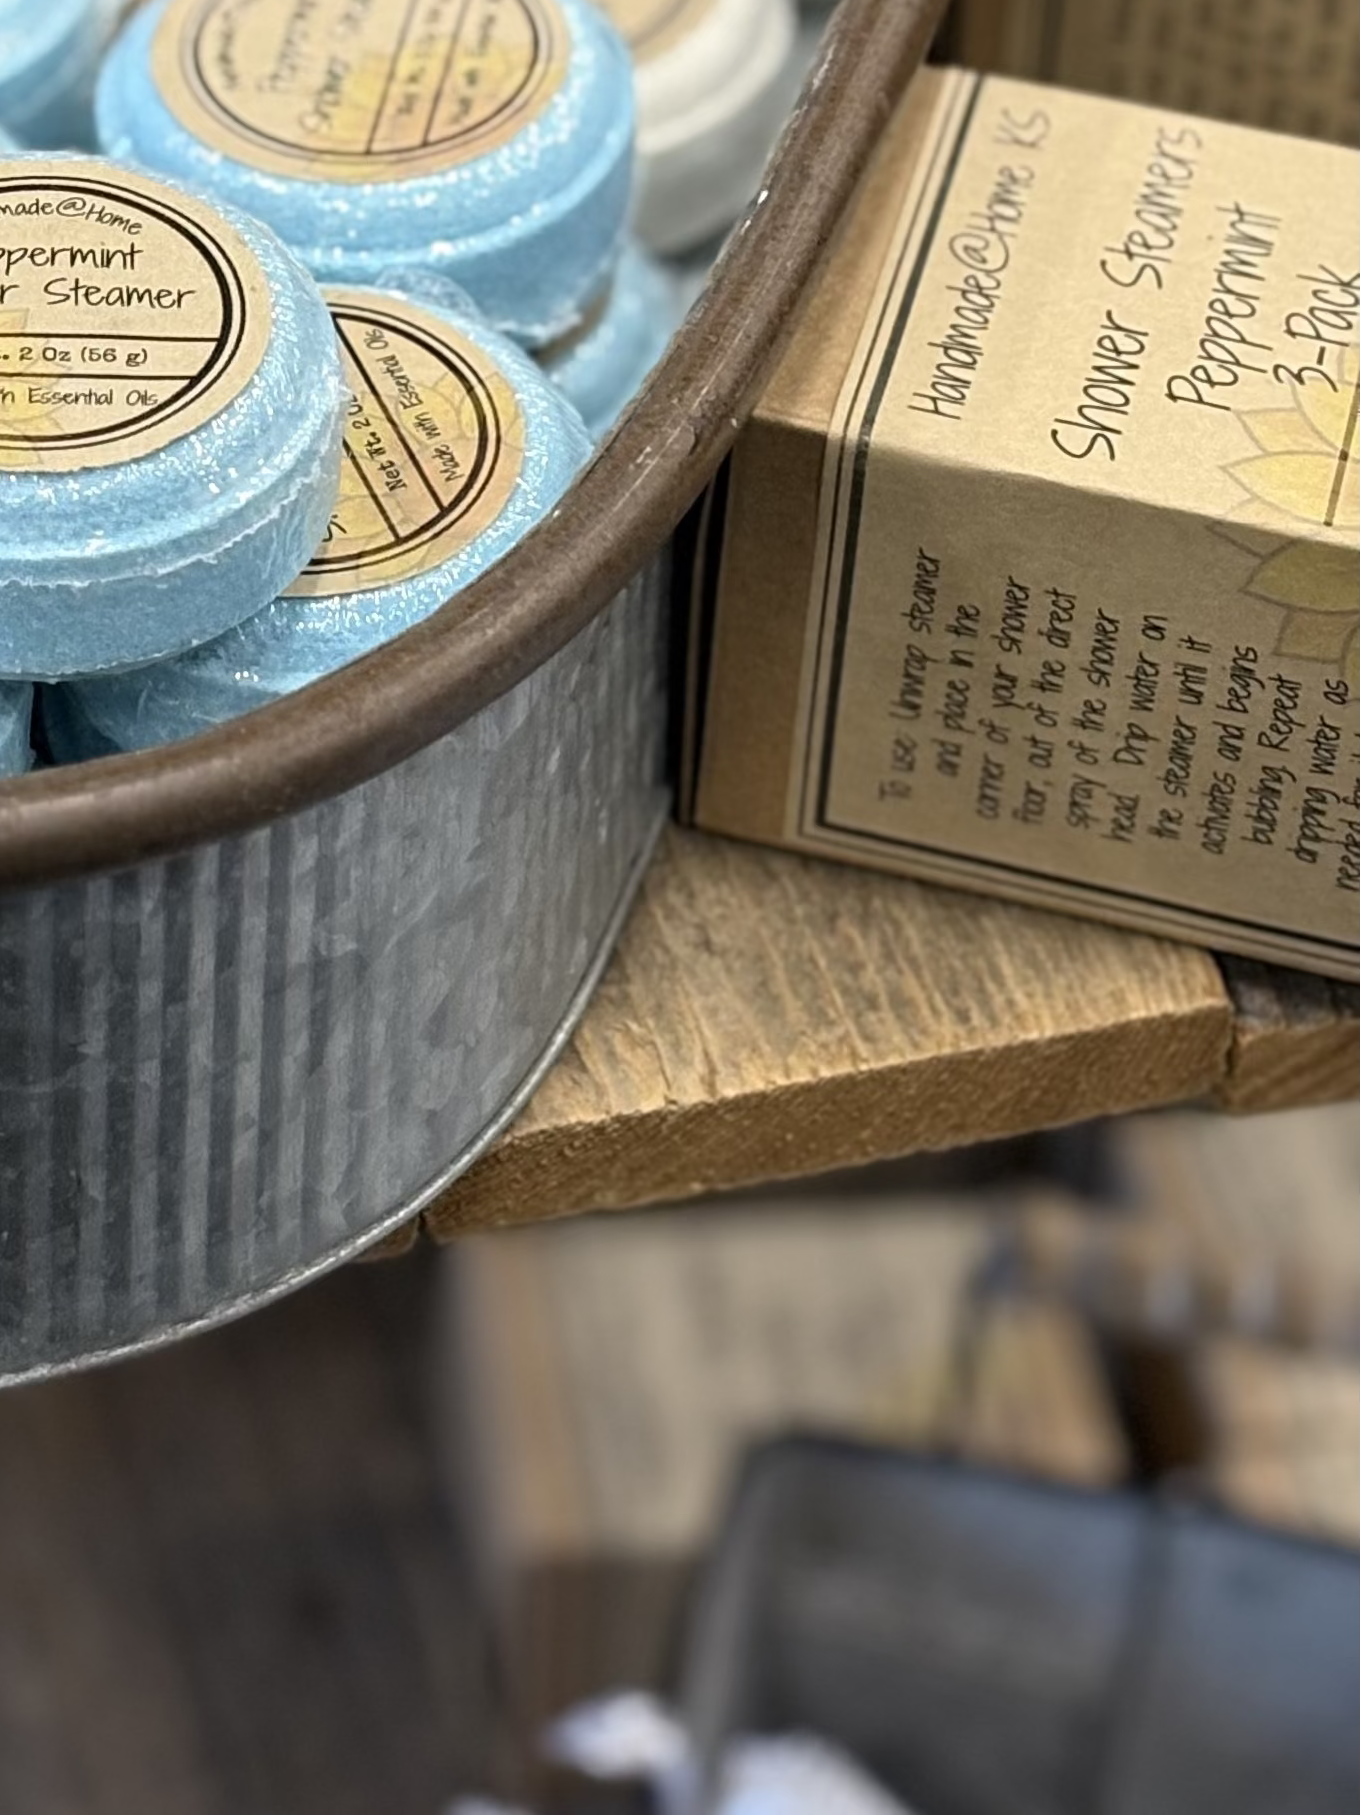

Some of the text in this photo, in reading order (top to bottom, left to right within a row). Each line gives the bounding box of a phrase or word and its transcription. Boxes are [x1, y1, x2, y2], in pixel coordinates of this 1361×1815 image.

[43, 278, 197, 309] Steamer
[907, 164, 1035, 420] Handmade@Home
[1051, 128, 1203, 461] Shower Steamers
[1165, 201, 1283, 411] Peppermint
[19, 346, 33, 361] 2
[41, 348, 72, 363] Oz
[80, 346, 117, 365] (56
[125, 346, 149, 367] g)
[1272, 264, 1360, 393] 3-Pack
[27, 387, 114, 406] Essential
[125, 388, 159, 407] Oils
[376, 355, 424, 411] Essential
[352, 416, 369, 431] 2
[414, 411, 442, 442] with
[376, 460, 407, 493] Net
[432, 444, 465, 483] Made
[901, 548, 940, 634] steamer
[1038, 587, 1077, 647] direct
[1142, 614, 1168, 641] on
[890, 644, 939, 720] Unwrap
[932, 603, 979, 777] and place in the
[977, 576, 1030, 820] corner of your shower
[1033, 658, 1066, 694] the
[1126, 651, 1160, 711] water
[1027, 702, 1059, 728] of
[1066, 608, 1120, 829] spray of the shower
[1148, 635, 1213, 841] the steamer until it
[1257, 673, 1306, 752] Repeat
[1023, 734, 1053, 768] out
[1113, 722, 1160, 767] Drip
[1200, 646, 1265, 854] activates and begins
[1286, 678, 1349, 864] dripping water as
